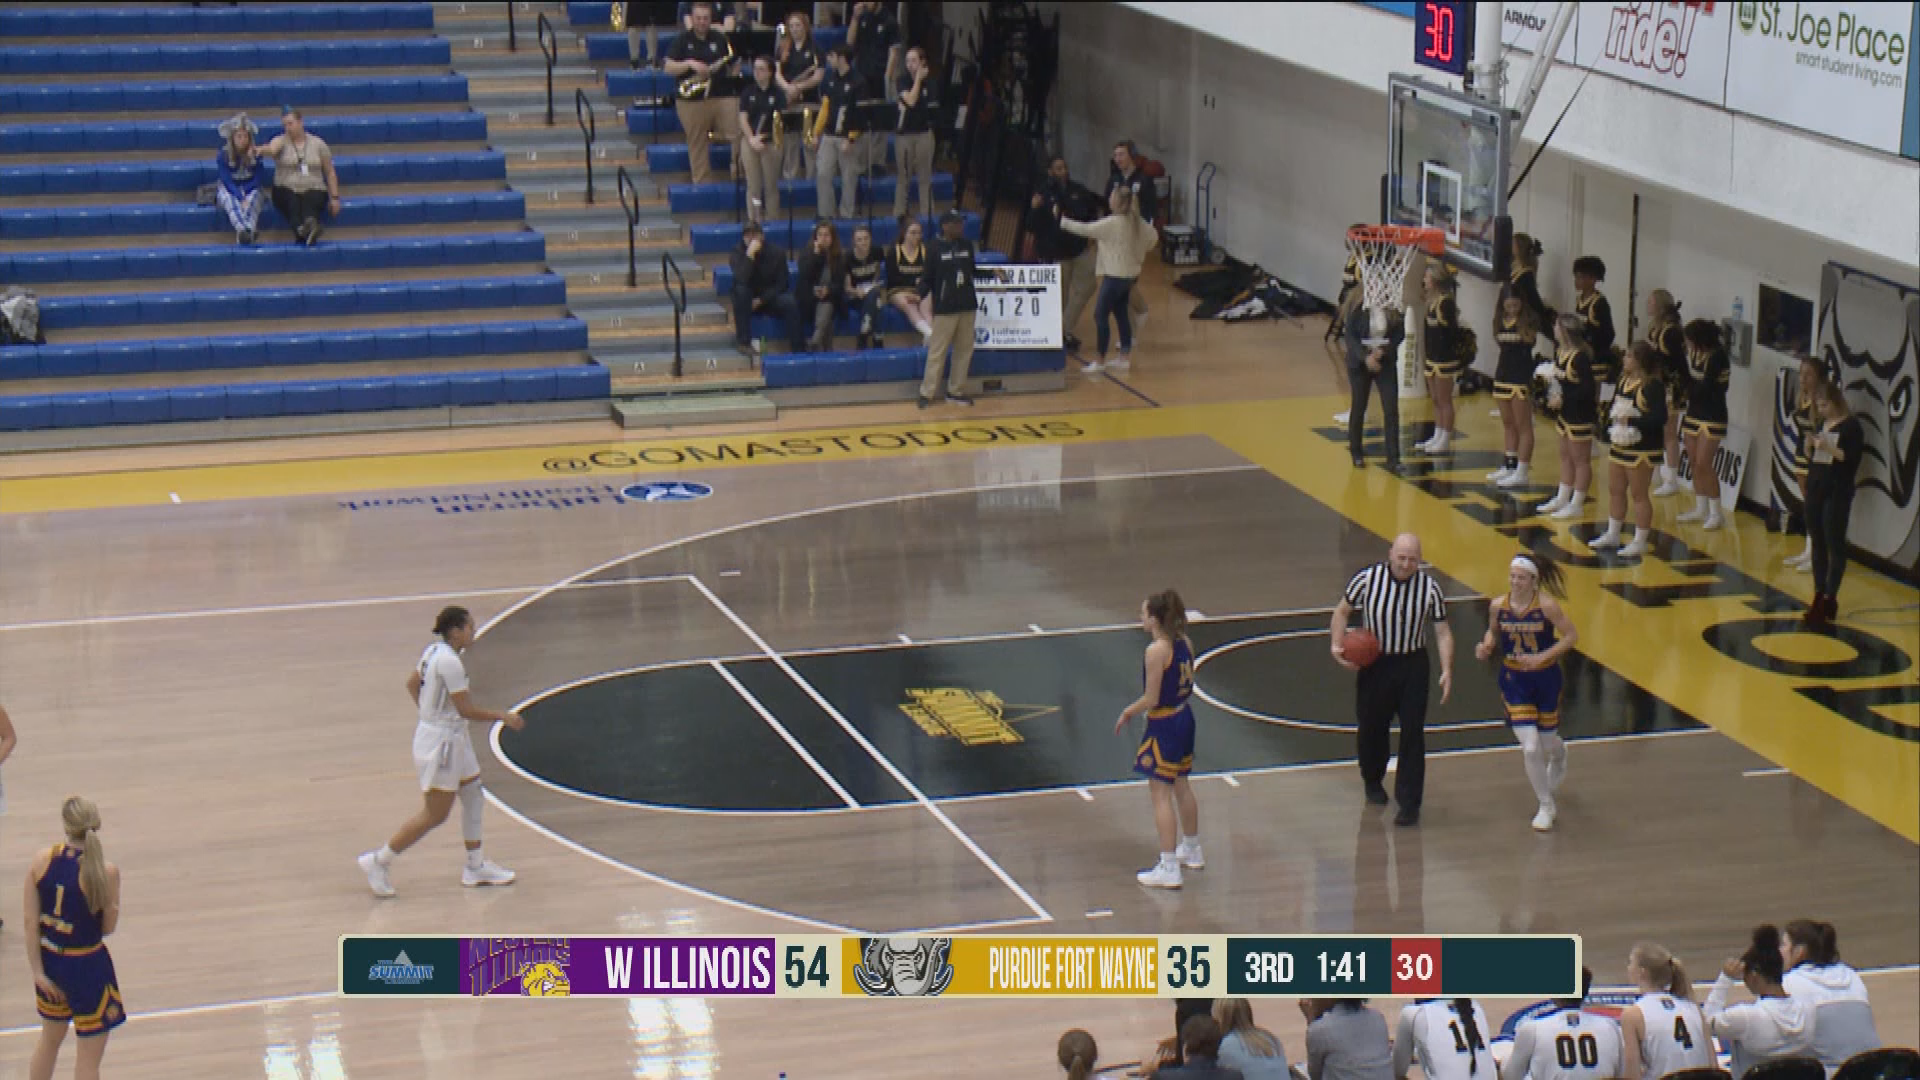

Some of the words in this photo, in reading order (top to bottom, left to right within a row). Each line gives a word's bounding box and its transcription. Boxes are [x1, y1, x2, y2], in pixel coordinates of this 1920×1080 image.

[1424, 3, 1454, 63] 30
[1504, 10, 1546, 32] ARMOU
[1605, 2, 1698, 78] ride!
[1760, 1, 1783, 39] St.
[1787, 2, 1832, 49] Joe
[1836, 11, 1905, 65] Place
[1029, 267, 1057, 284] CURE
[542, 420, 1085, 474] @GOMASTODONS
[1556, 1032, 1599, 1070] 00
[1674, 1015, 1694, 1050] 4
